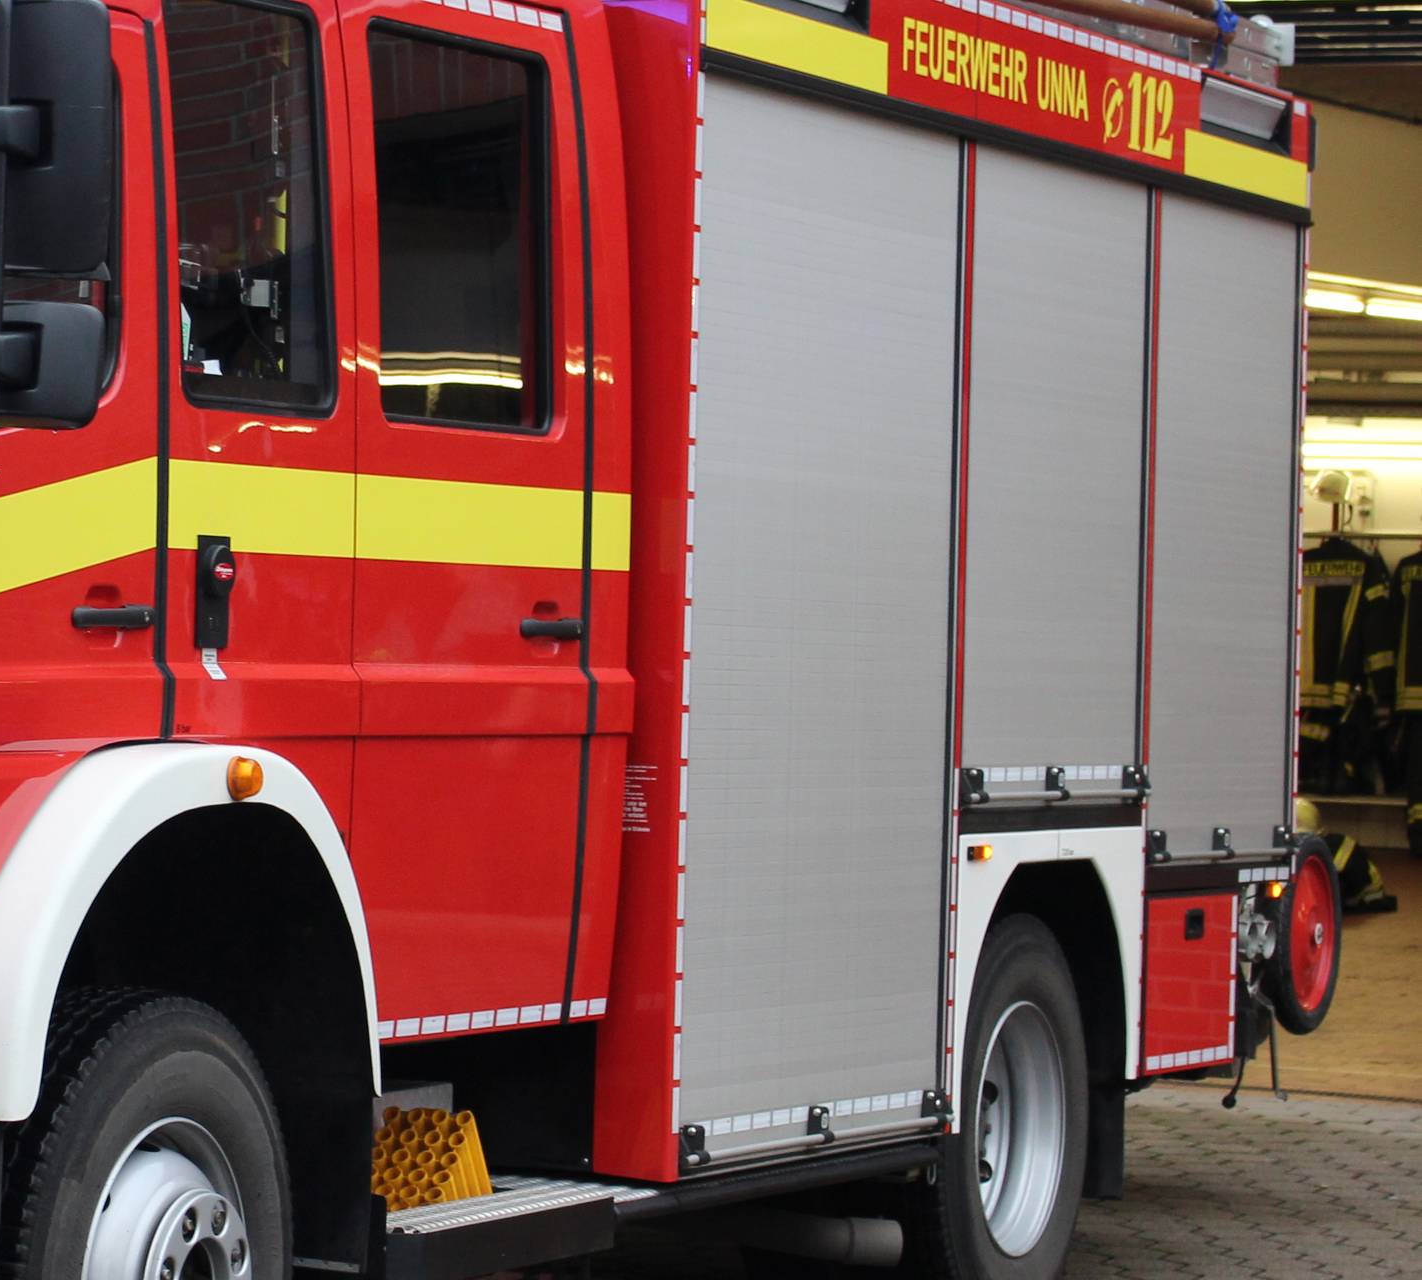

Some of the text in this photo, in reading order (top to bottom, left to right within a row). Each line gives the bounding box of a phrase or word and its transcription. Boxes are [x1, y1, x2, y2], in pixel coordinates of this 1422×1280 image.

[903, 16, 1174, 160] FEUERWEHR UNNA 112
